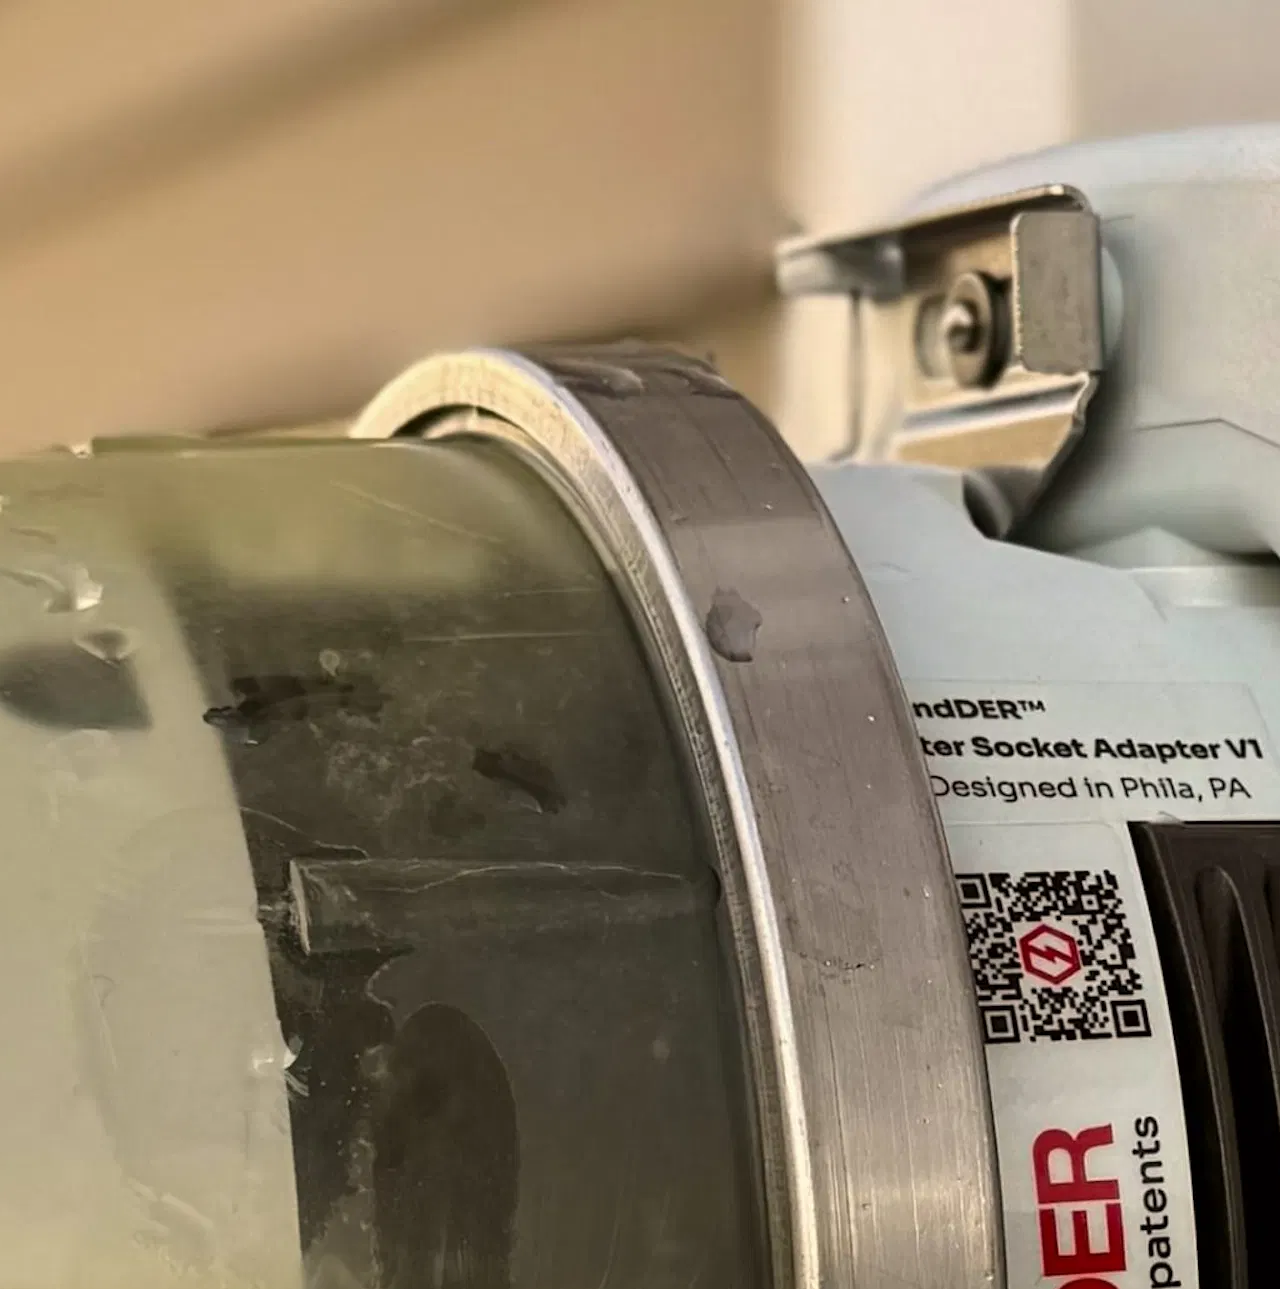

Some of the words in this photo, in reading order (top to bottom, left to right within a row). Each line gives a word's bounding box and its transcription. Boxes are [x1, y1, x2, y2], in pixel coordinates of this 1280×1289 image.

[971, 736, 1088, 759] Socket
[1094, 737, 1221, 764] Adapter
[1225, 738, 1264, 760] V1
[929, 775, 1078, 803] Designed
[1084, 776, 1115, 799] in
[1120, 776, 1204, 803] Phila,
[1209, 777, 1252, 800] PA
